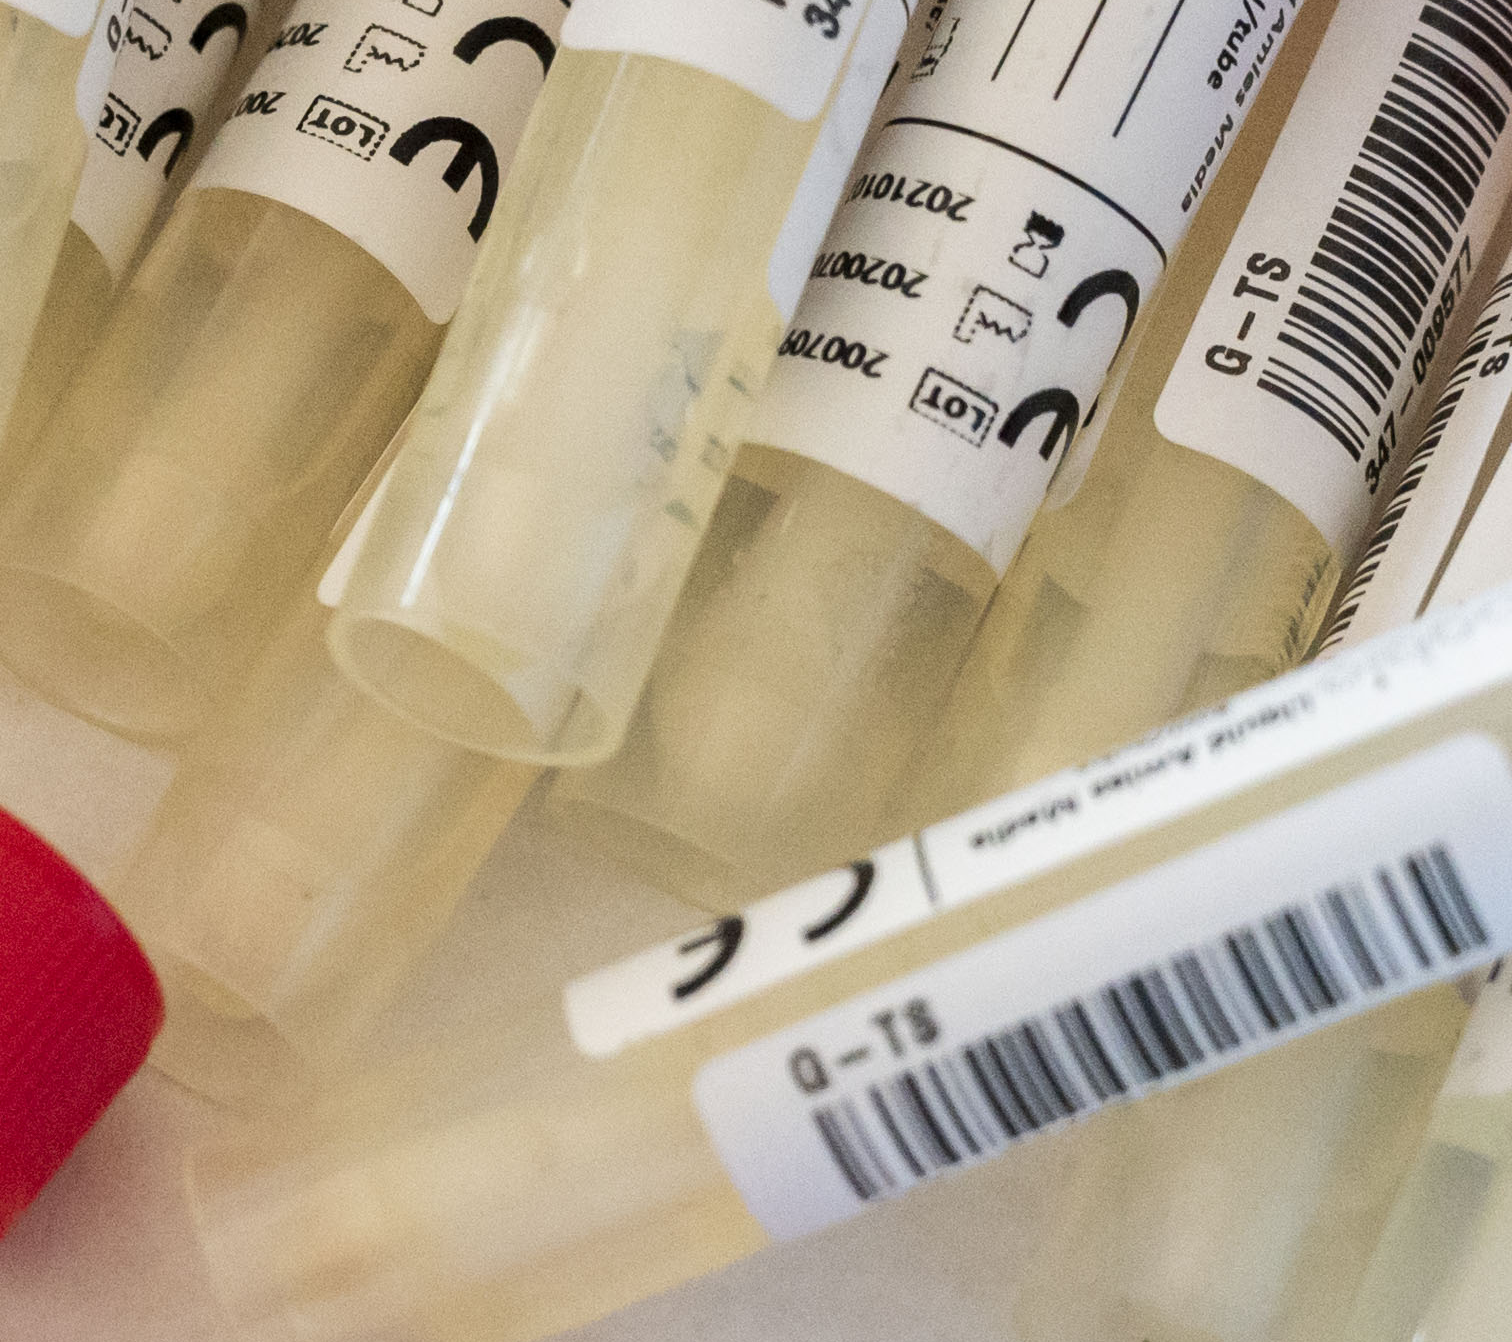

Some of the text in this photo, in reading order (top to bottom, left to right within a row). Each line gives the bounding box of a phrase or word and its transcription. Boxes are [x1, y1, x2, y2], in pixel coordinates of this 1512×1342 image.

[1234, 10, 1286, 107] Amies
[306, 100, 378, 149] LOT
[1204, 251, 1293, 377] G-TS
[918, 381, 990, 435] LOT
